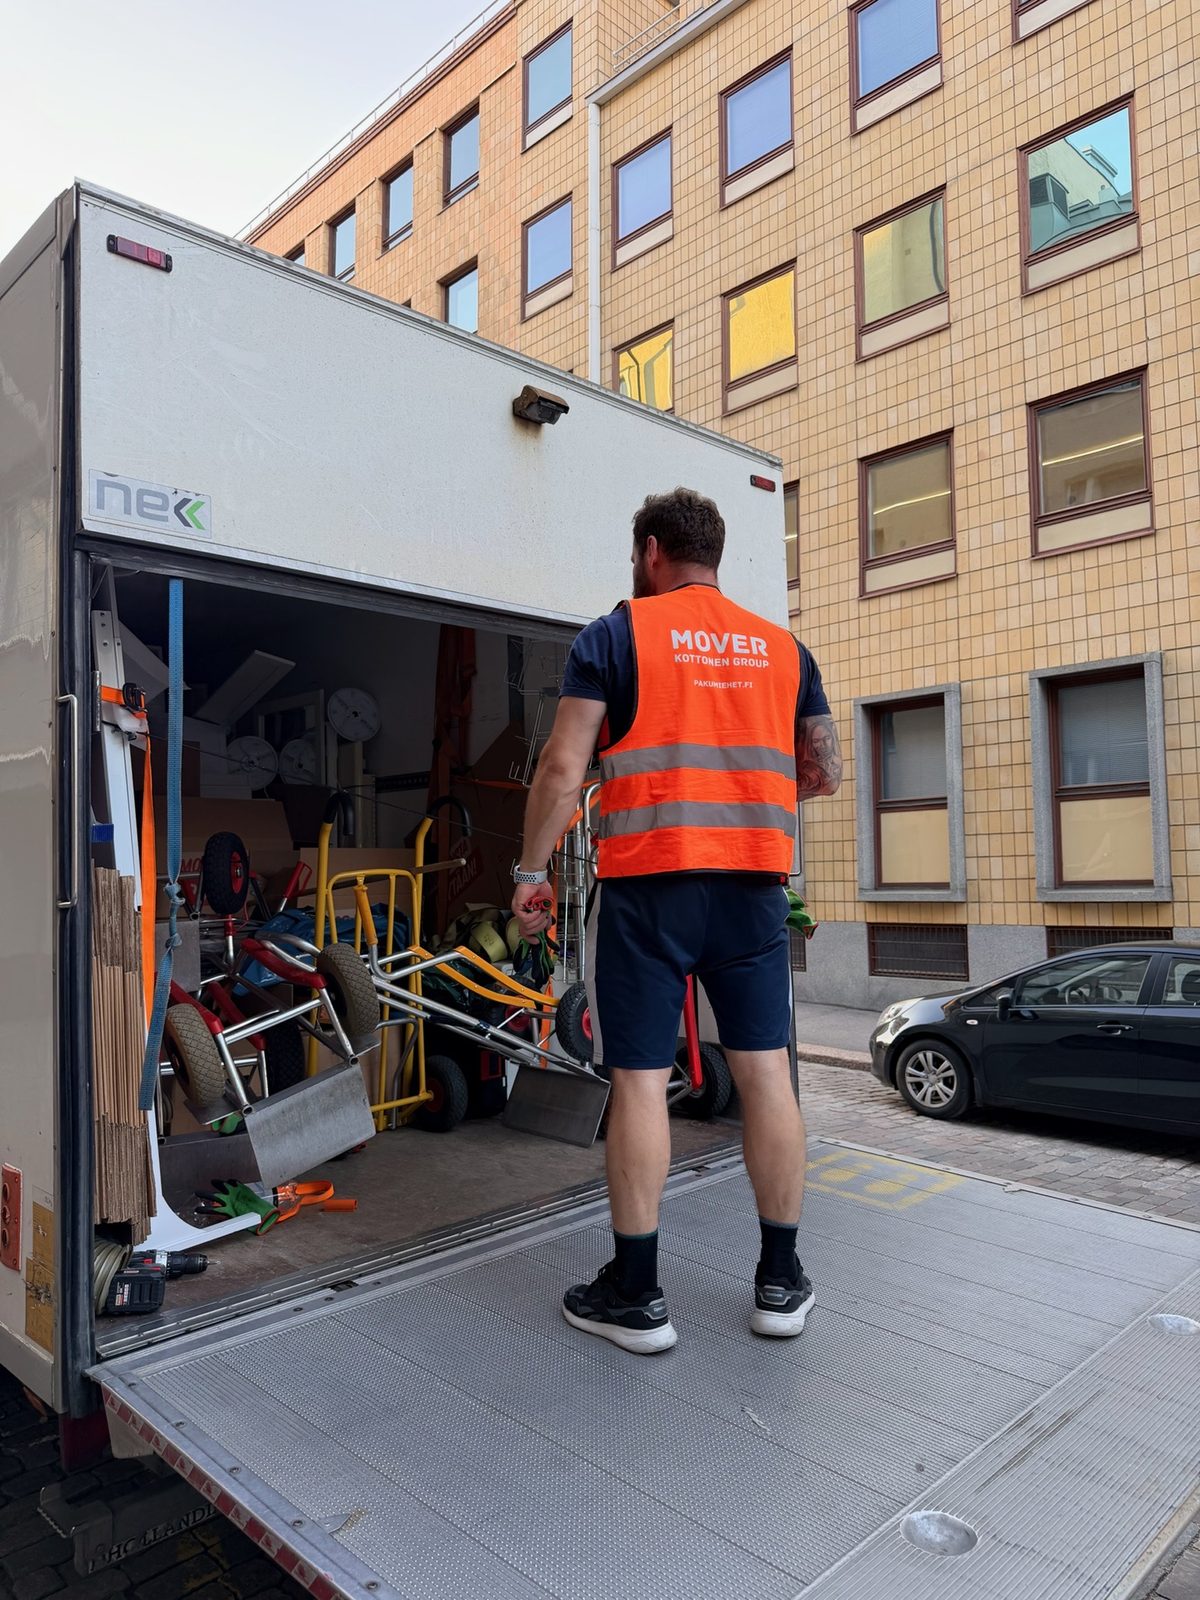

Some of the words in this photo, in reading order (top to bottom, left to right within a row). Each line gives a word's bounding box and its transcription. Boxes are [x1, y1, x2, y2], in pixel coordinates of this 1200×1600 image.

[670, 629, 768, 656] MOVER
[674, 654, 730, 667] KOTTONEN
[733, 657, 769, 669] GROUP
